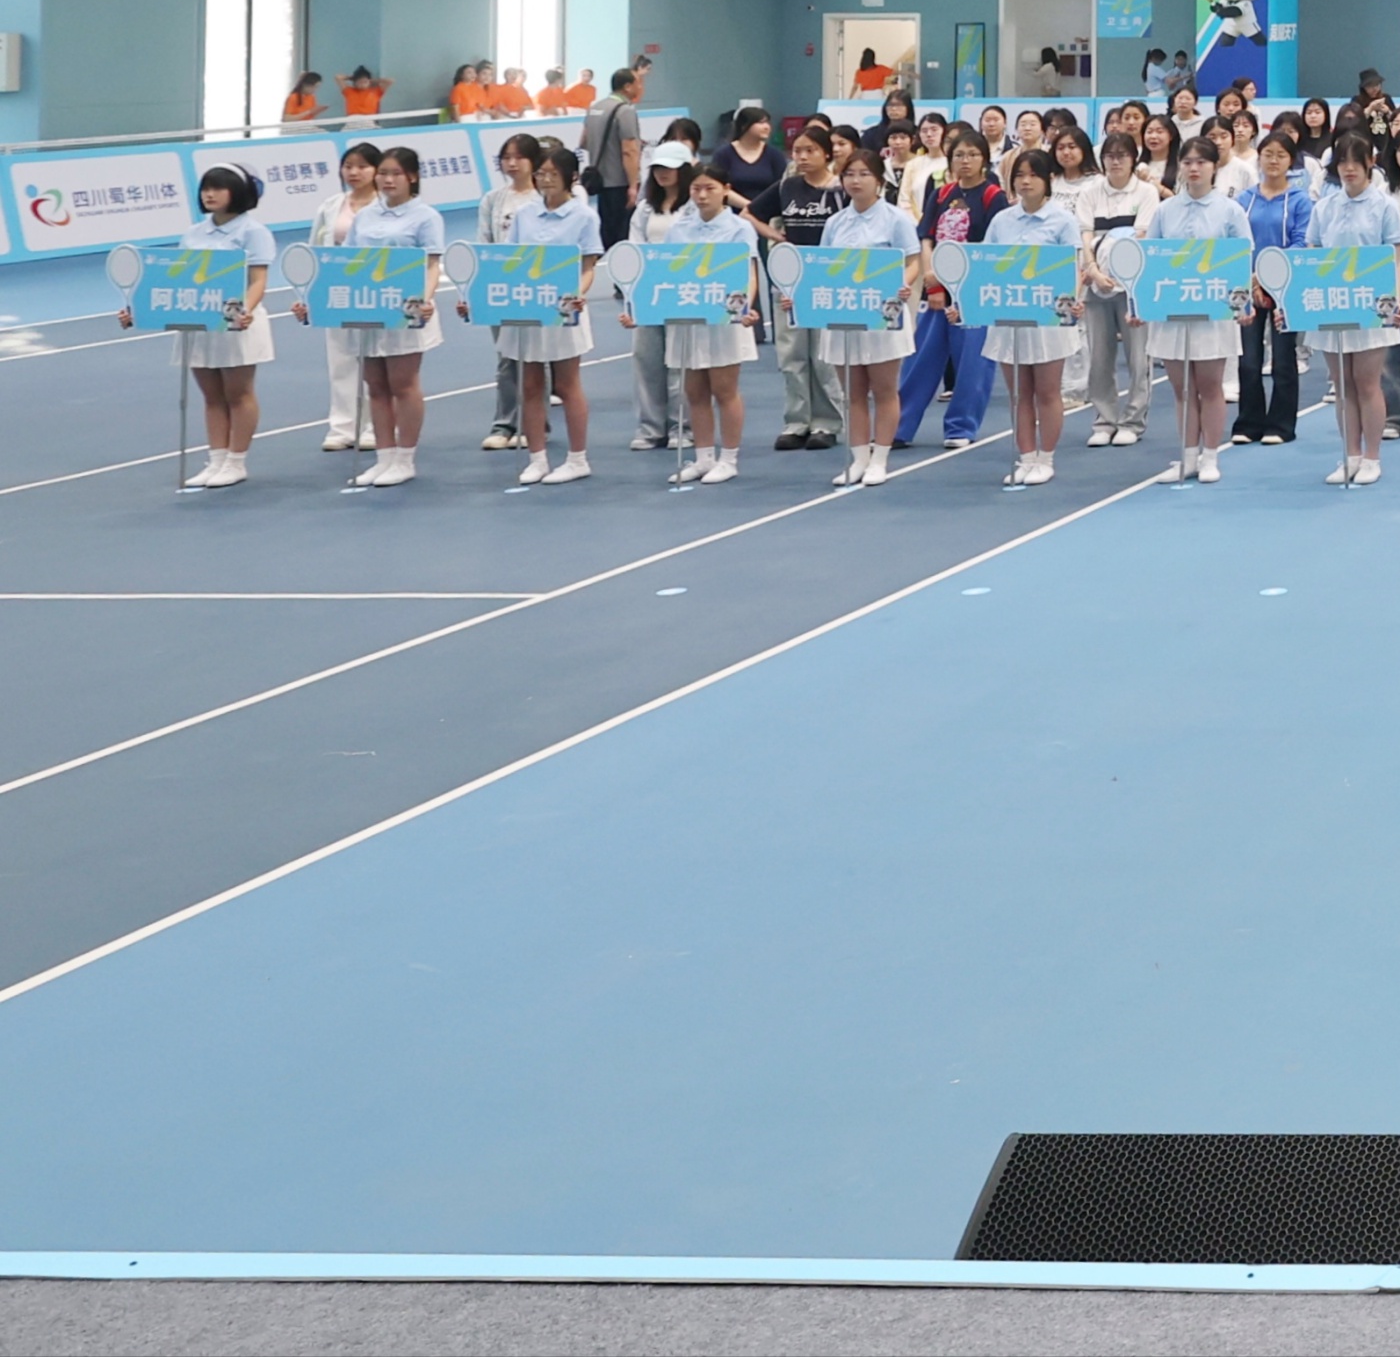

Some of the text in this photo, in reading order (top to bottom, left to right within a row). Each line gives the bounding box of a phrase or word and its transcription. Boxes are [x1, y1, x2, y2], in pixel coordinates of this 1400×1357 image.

[266, 161, 329, 183] 成都赛事
[71, 183, 178, 208] 四川蜀华川体
[150, 286, 224, 313] 阿坝州
[327, 285, 402, 309] 眉山市
[488, 283, 558, 306] 巴中市
[651, 282, 725, 307] 广安市
[812, 286, 881, 310] 南充市
[980, 283, 1053, 307] 内江市
[1153, 277, 1228, 302] 广元市
[1302, 286, 1374, 311] 德阳市
